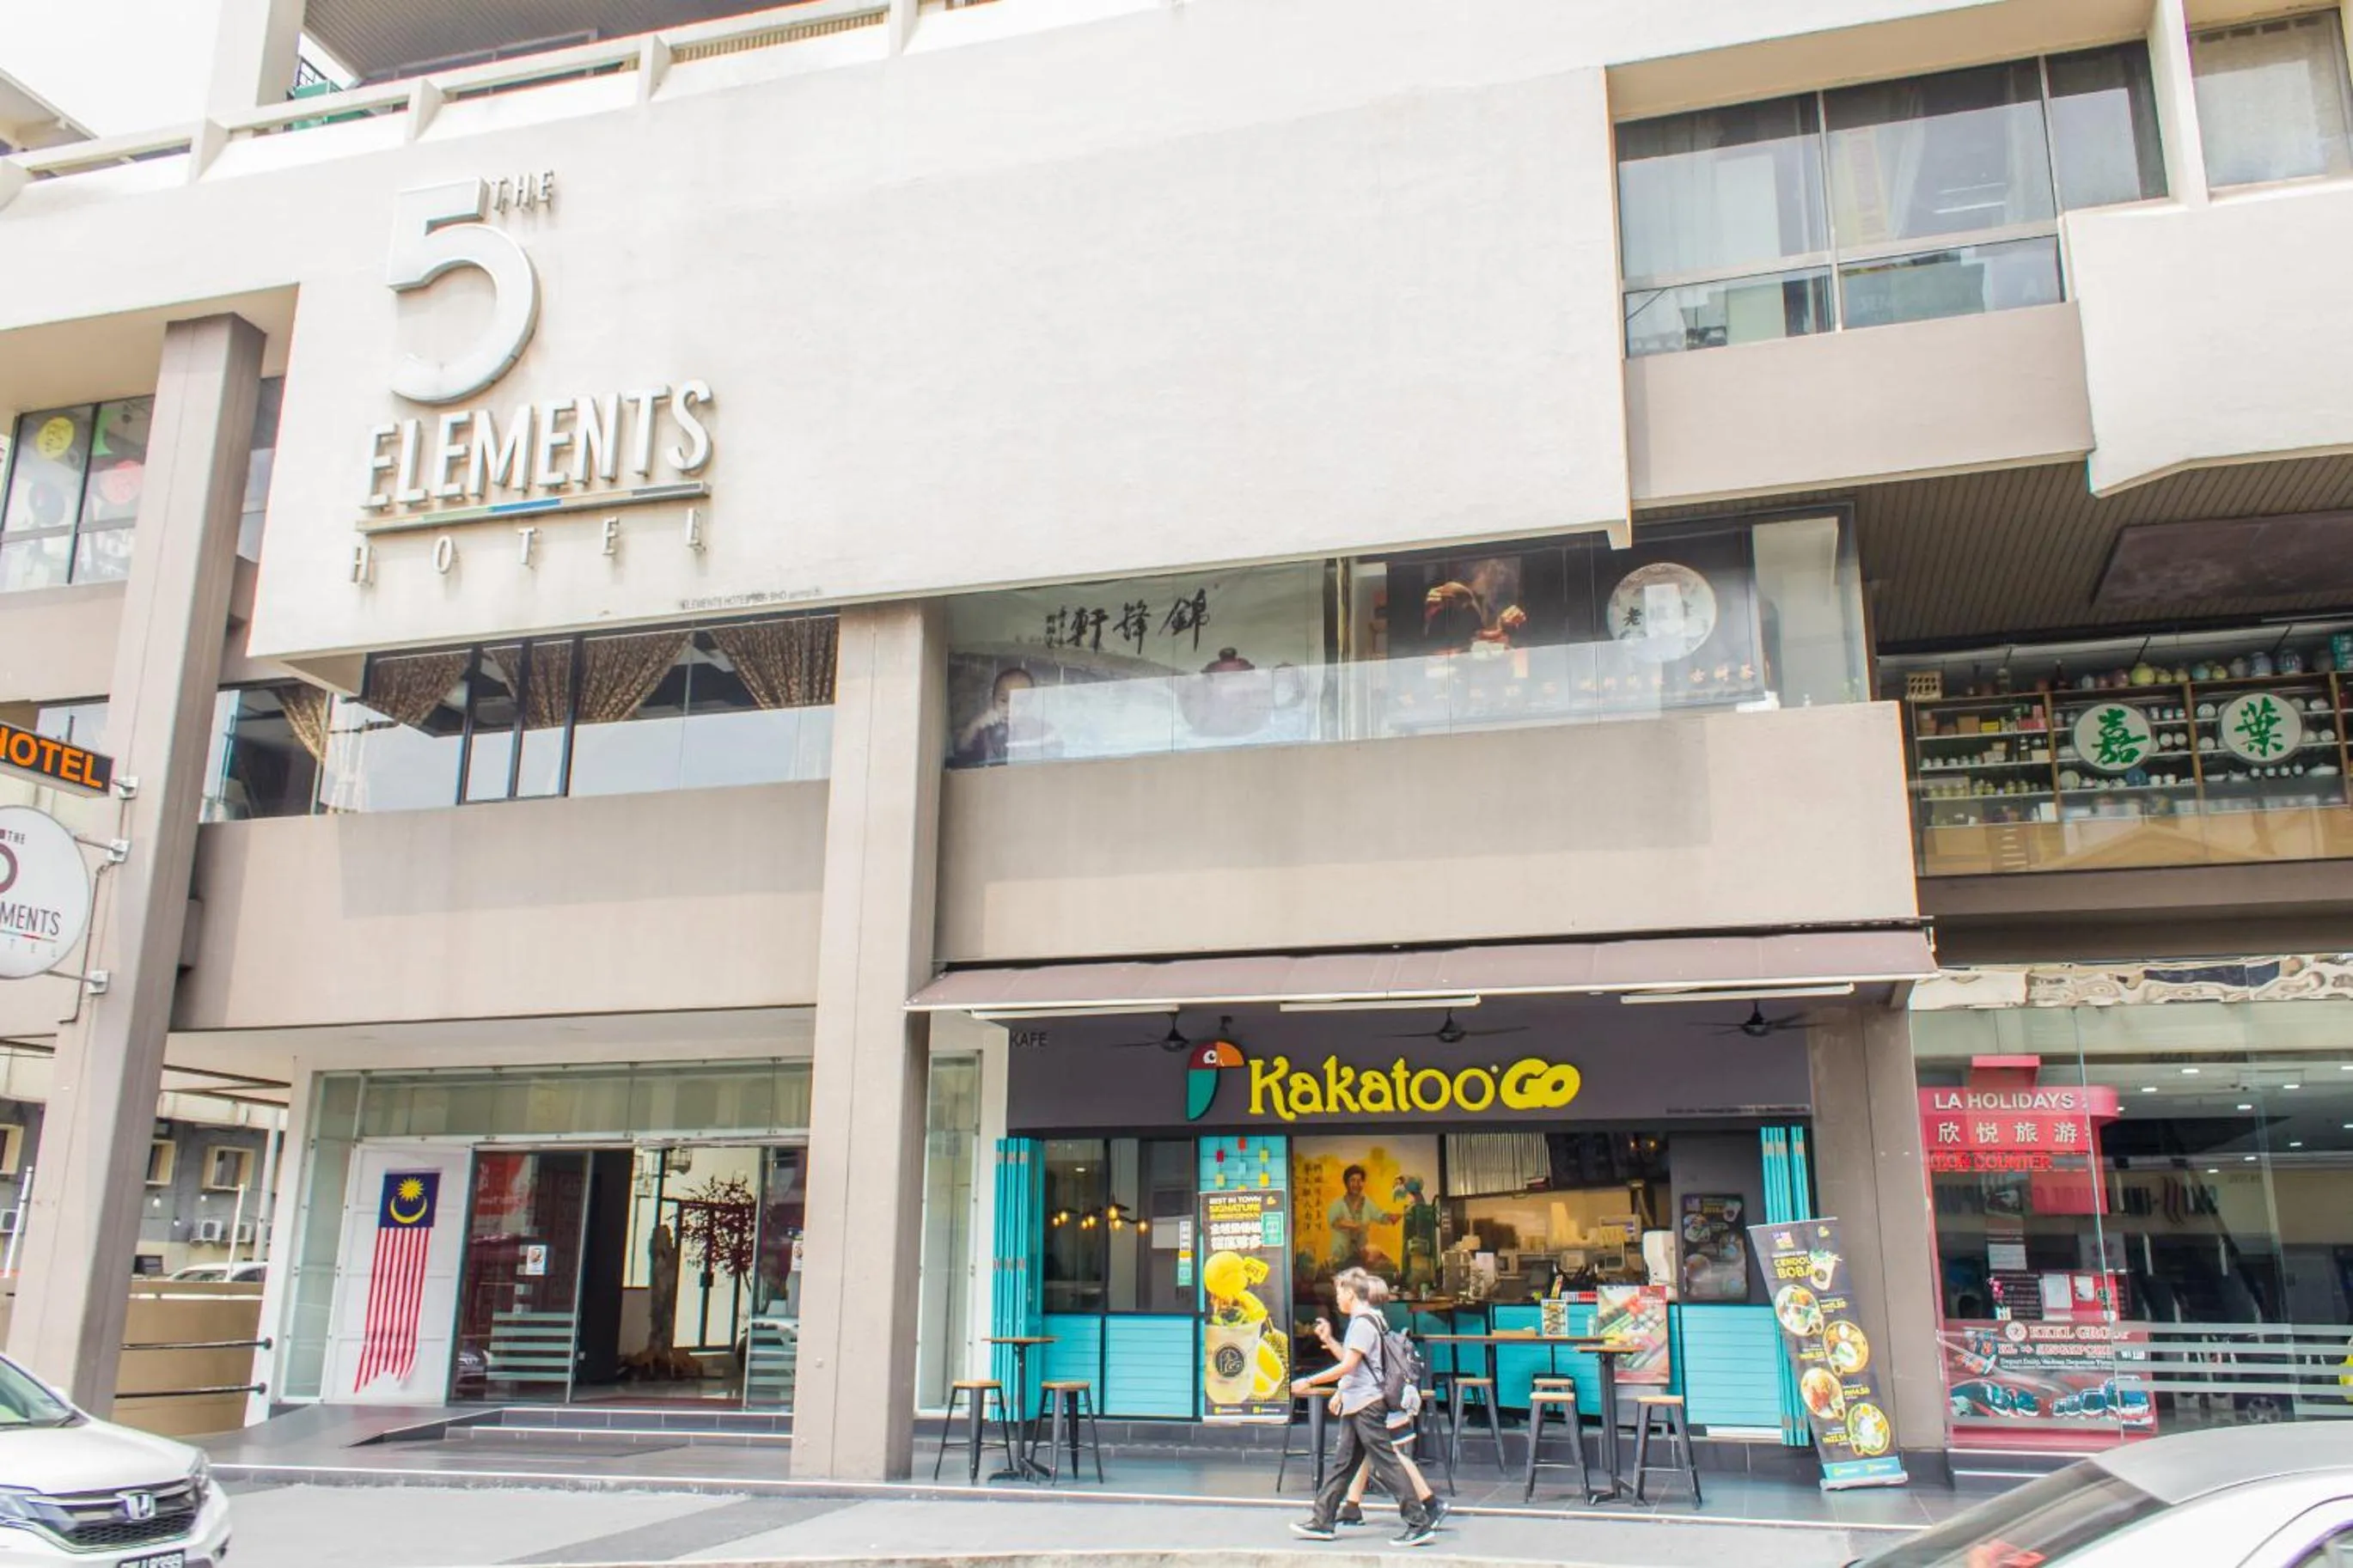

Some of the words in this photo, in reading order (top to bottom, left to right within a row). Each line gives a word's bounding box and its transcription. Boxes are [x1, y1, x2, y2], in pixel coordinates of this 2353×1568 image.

[492, 171, 555, 213] THE
[387, 176, 542, 404] 5
[360, 379, 714, 511] ELEMENTS
[350, 508, 706, 588] HOTEL
[8, 830, 26, 845] THE
[1009, 1031, 1048, 1047] KAFE
[1248, 1055, 1495, 1120] Kakatoo
[1934, 1093, 1964, 1110] LA
[1967, 1092, 2075, 1110] HOLIDAYS
[1938, 1121, 2078, 1144] 欣悦旅游
